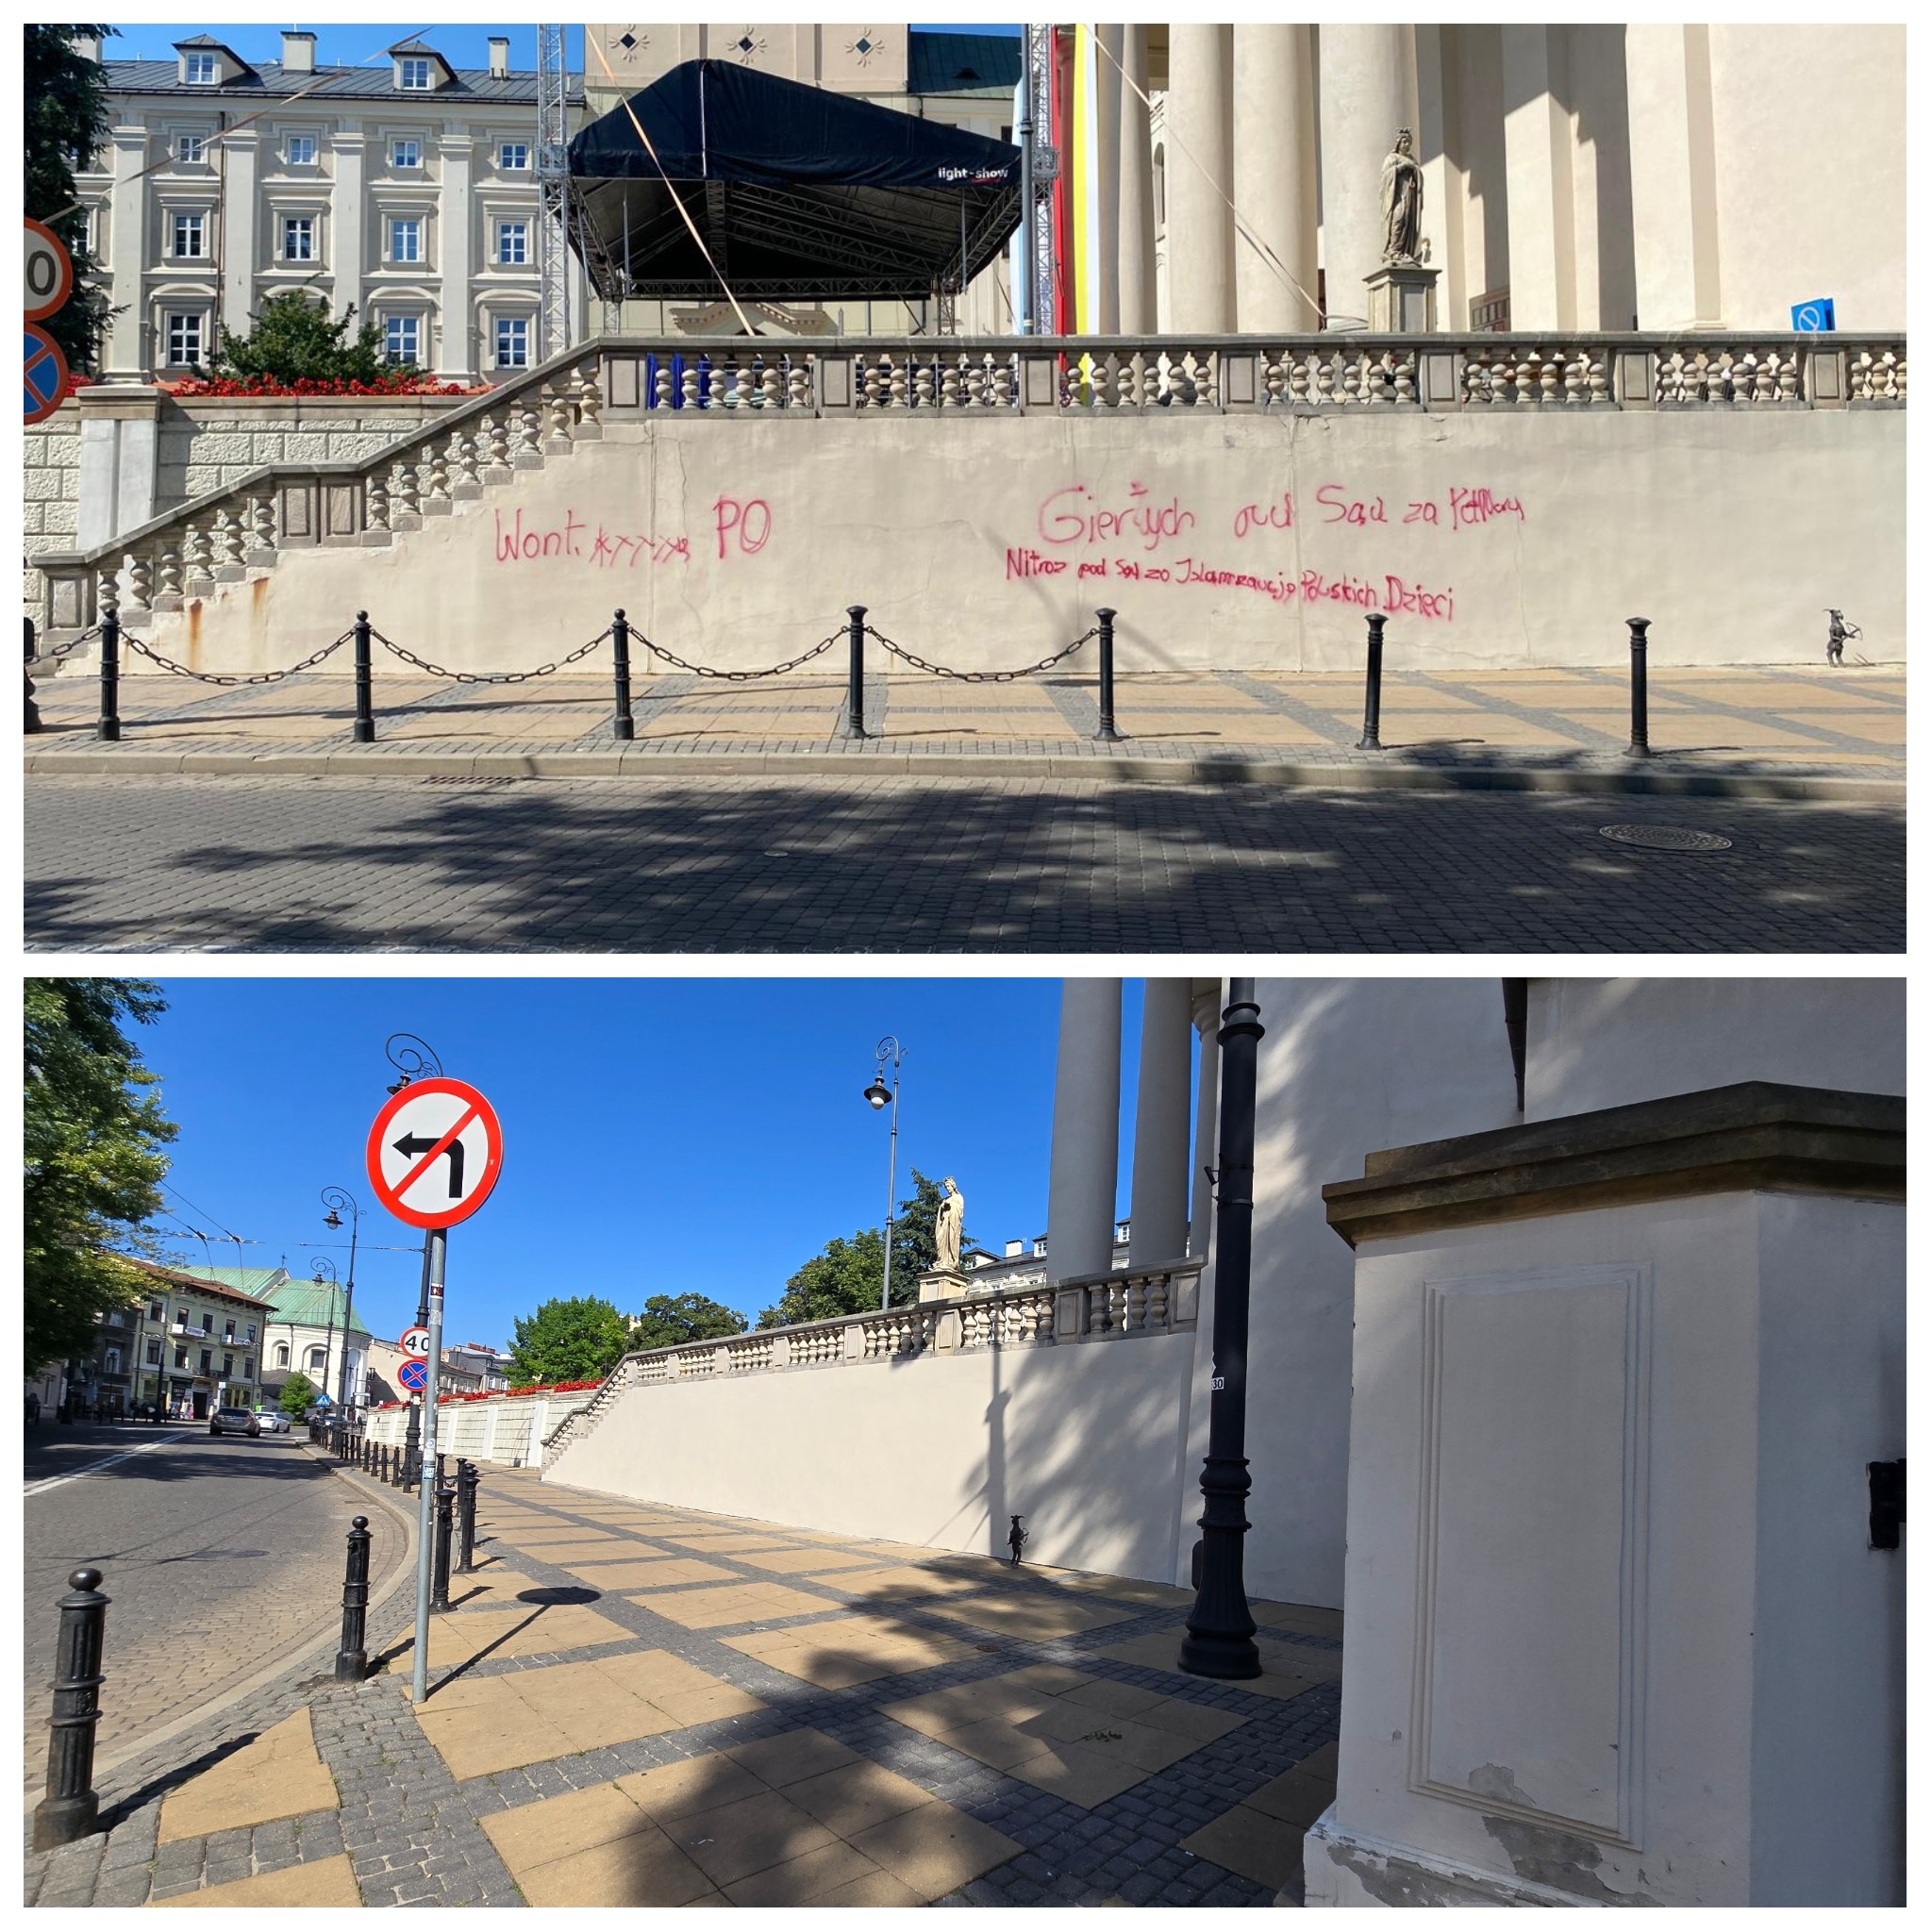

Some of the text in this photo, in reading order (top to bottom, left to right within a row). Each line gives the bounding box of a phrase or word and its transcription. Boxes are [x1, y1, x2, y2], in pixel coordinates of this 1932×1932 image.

[938, 167, 1008, 180] light-show
[713, 496, 772, 559] PO
[405, 1335, 430, 1351] 40
